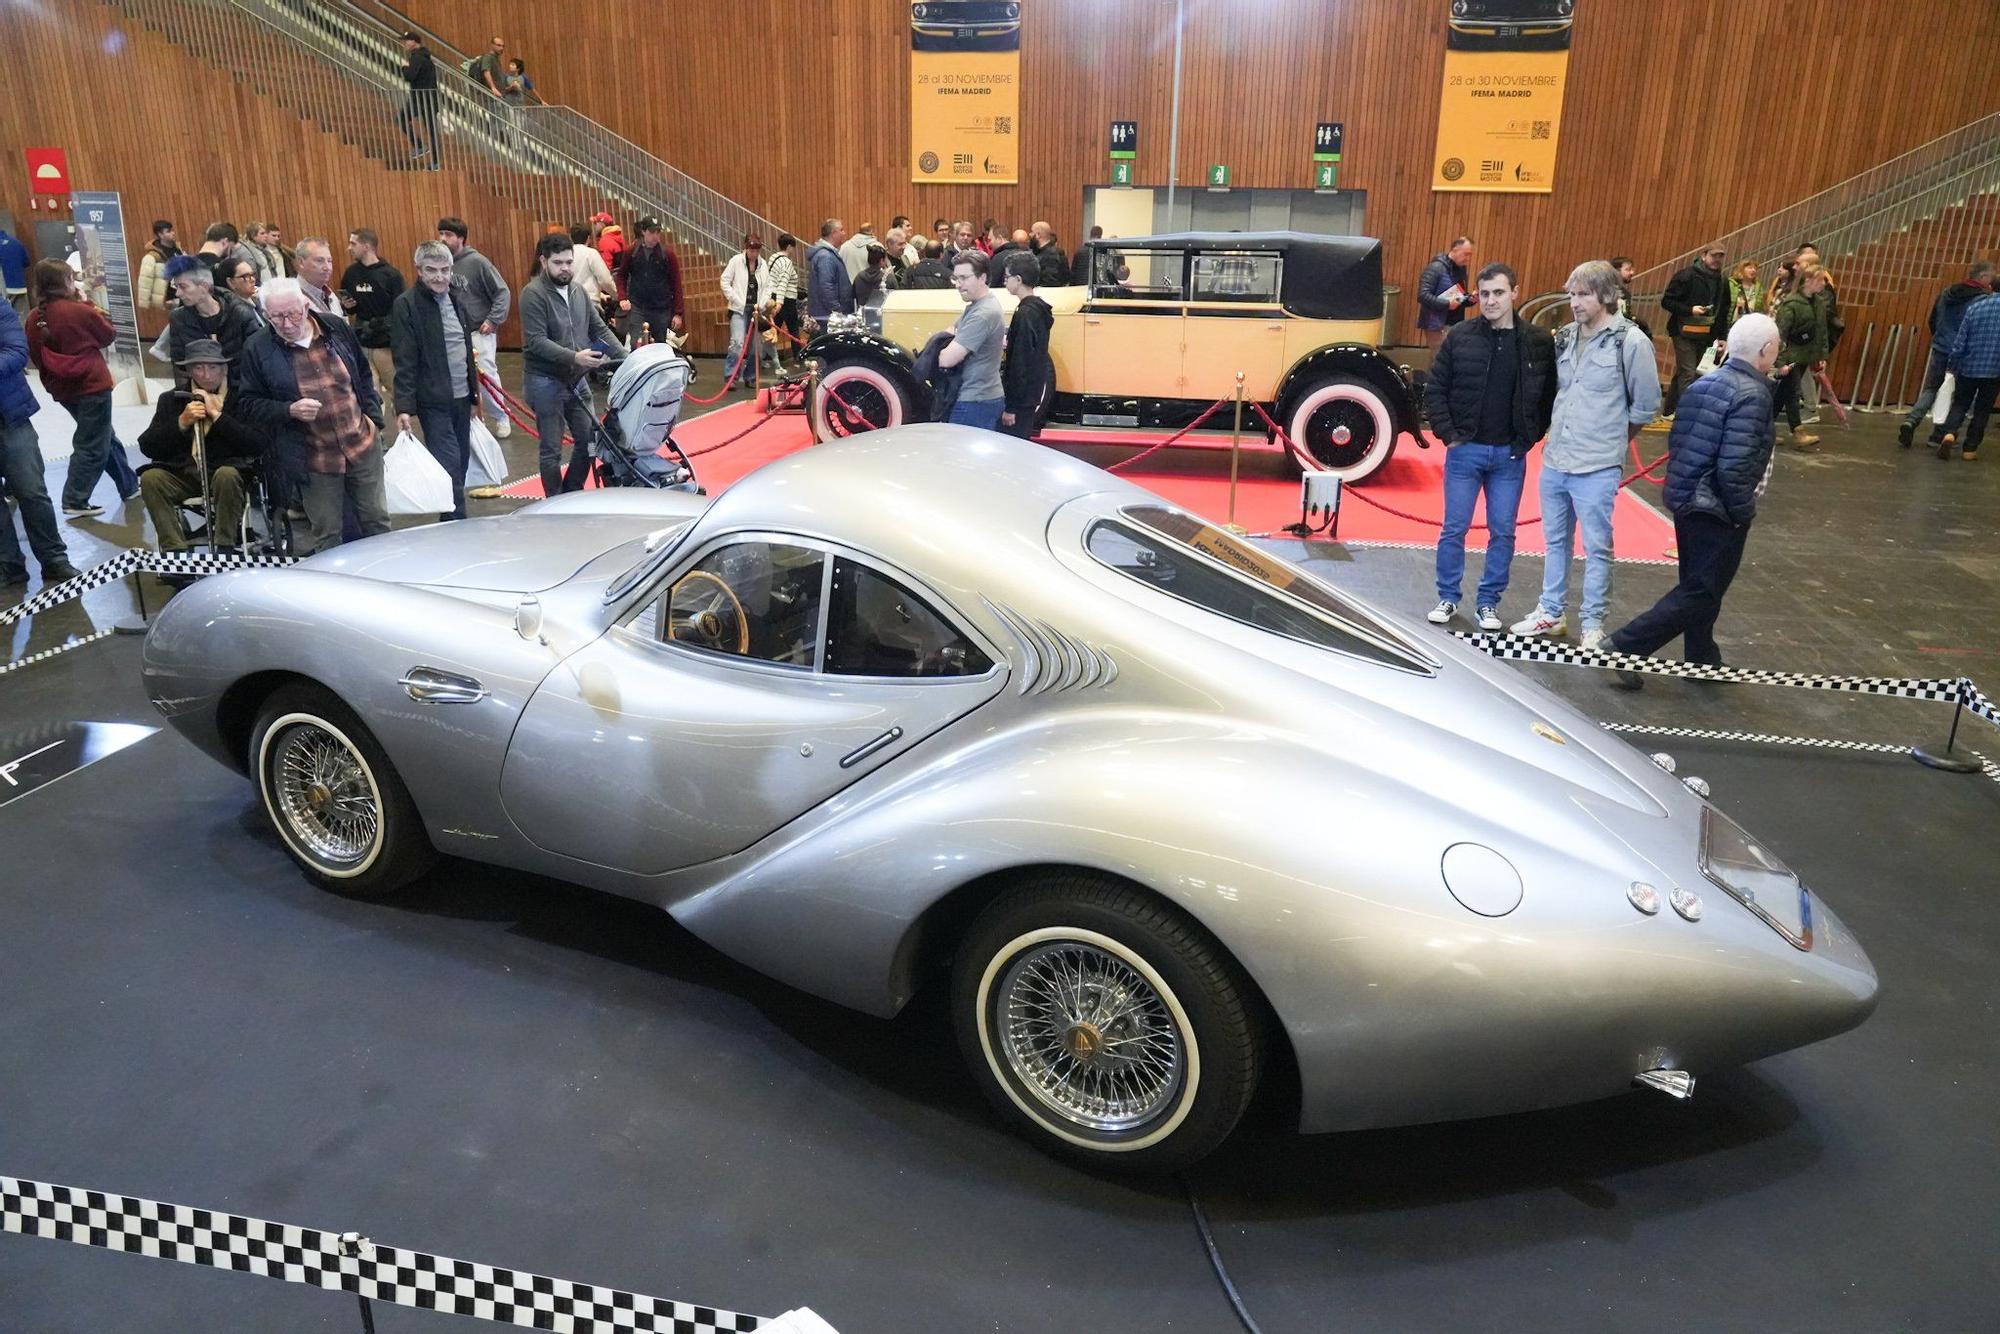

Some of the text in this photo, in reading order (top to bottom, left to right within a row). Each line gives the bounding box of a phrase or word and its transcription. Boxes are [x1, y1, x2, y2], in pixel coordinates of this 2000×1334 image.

[918, 74, 1012, 84] 28 al 30 NOVIEMBRE
[1450, 75, 1557, 86] 28 al 30 NOVIEMBRE
[1471, 90, 1532, 98] IFEMA MADRID
[89, 210, 104, 222] 1957
